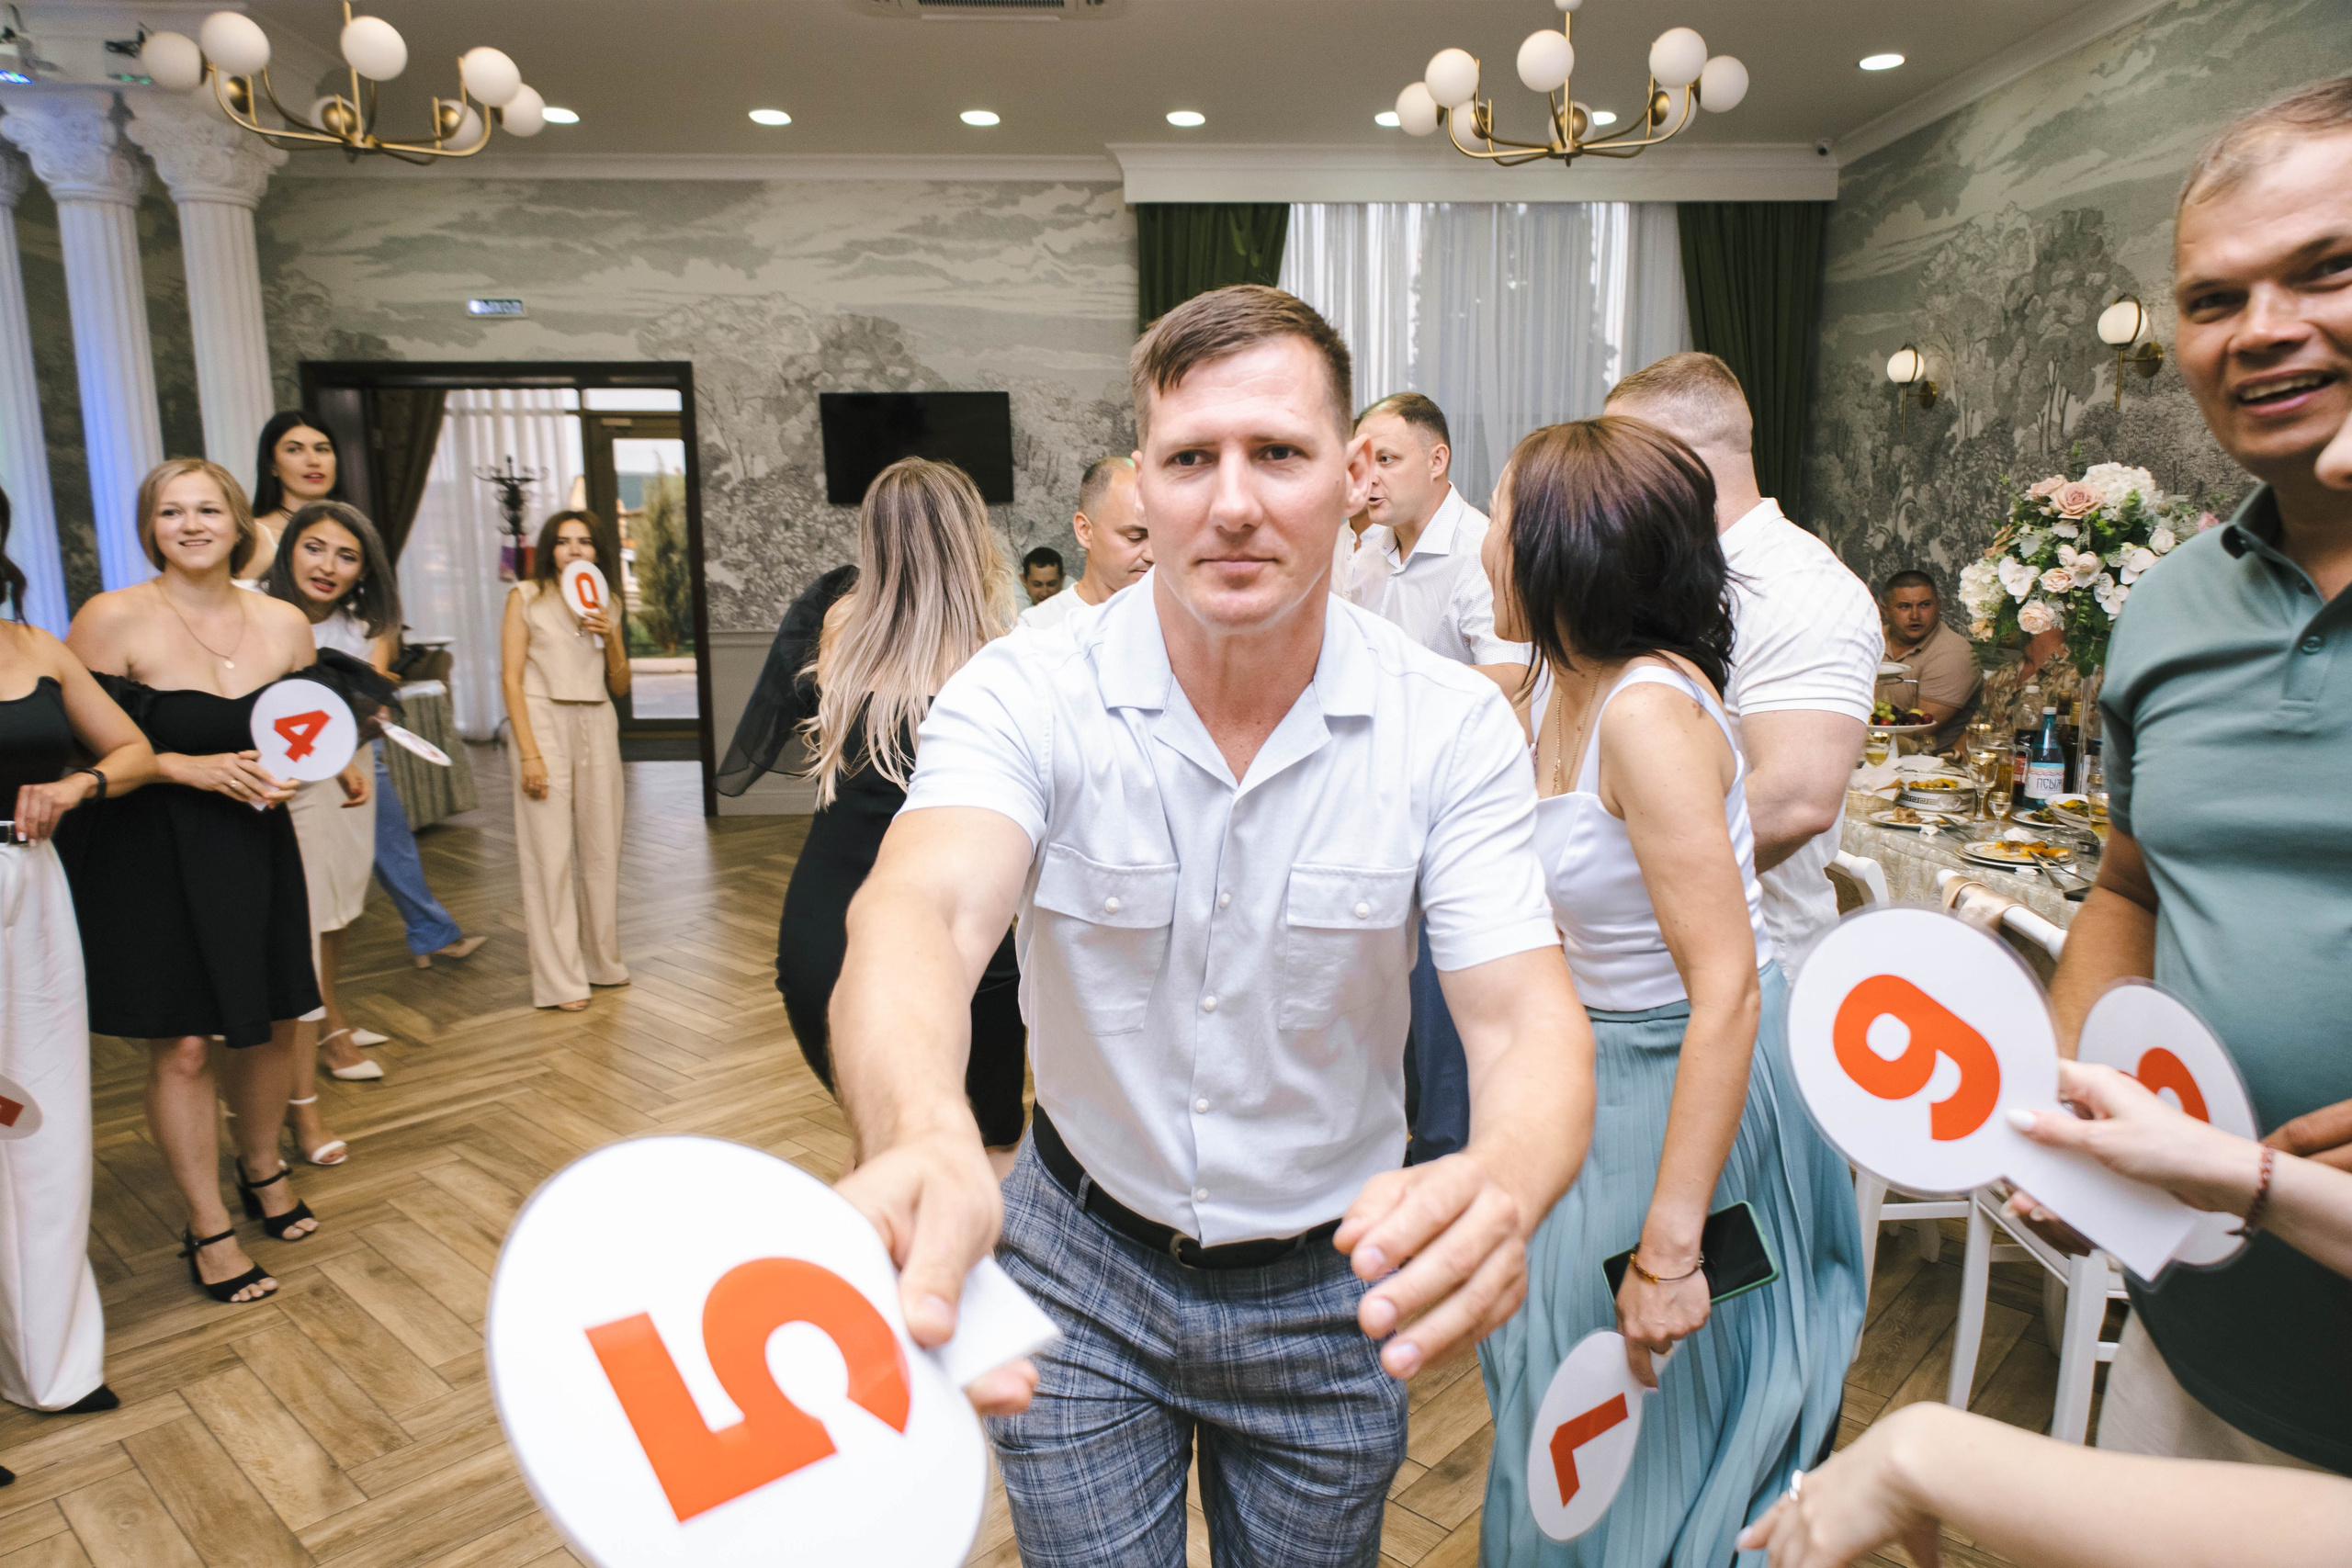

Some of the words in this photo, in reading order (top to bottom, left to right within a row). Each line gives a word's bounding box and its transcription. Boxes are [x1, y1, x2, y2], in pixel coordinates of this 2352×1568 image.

[274, 709, 333, 762] 4
[1832, 974, 2001, 1141] 9
[584, 1256, 910, 1524] 5
[1549, 1392, 1629, 1508] 7
